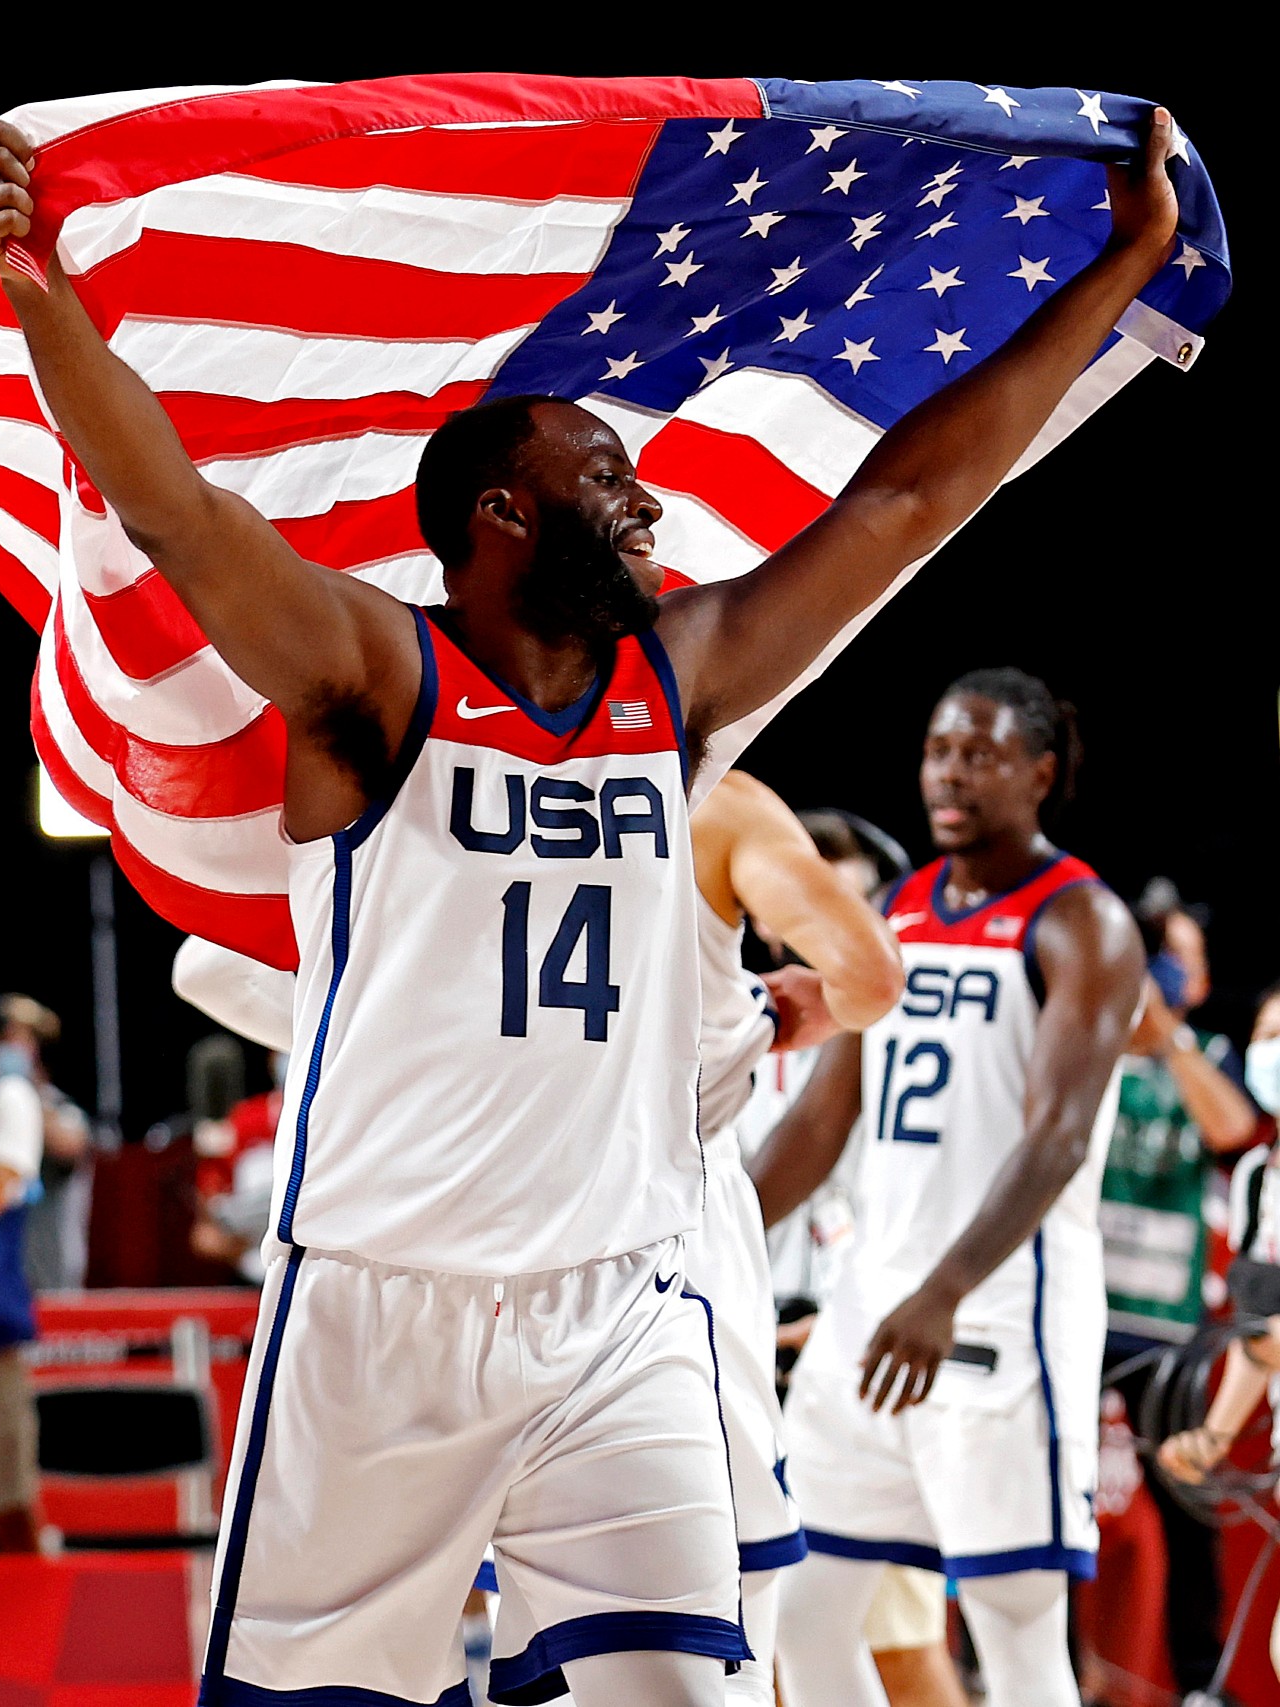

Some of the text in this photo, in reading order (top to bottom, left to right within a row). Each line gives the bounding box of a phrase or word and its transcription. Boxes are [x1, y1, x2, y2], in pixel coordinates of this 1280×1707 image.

[449, 766, 670, 860] USA
[500, 880, 620, 1042] 14
[900, 965, 1000, 1023] SA
[876, 1037, 951, 1145] 12
